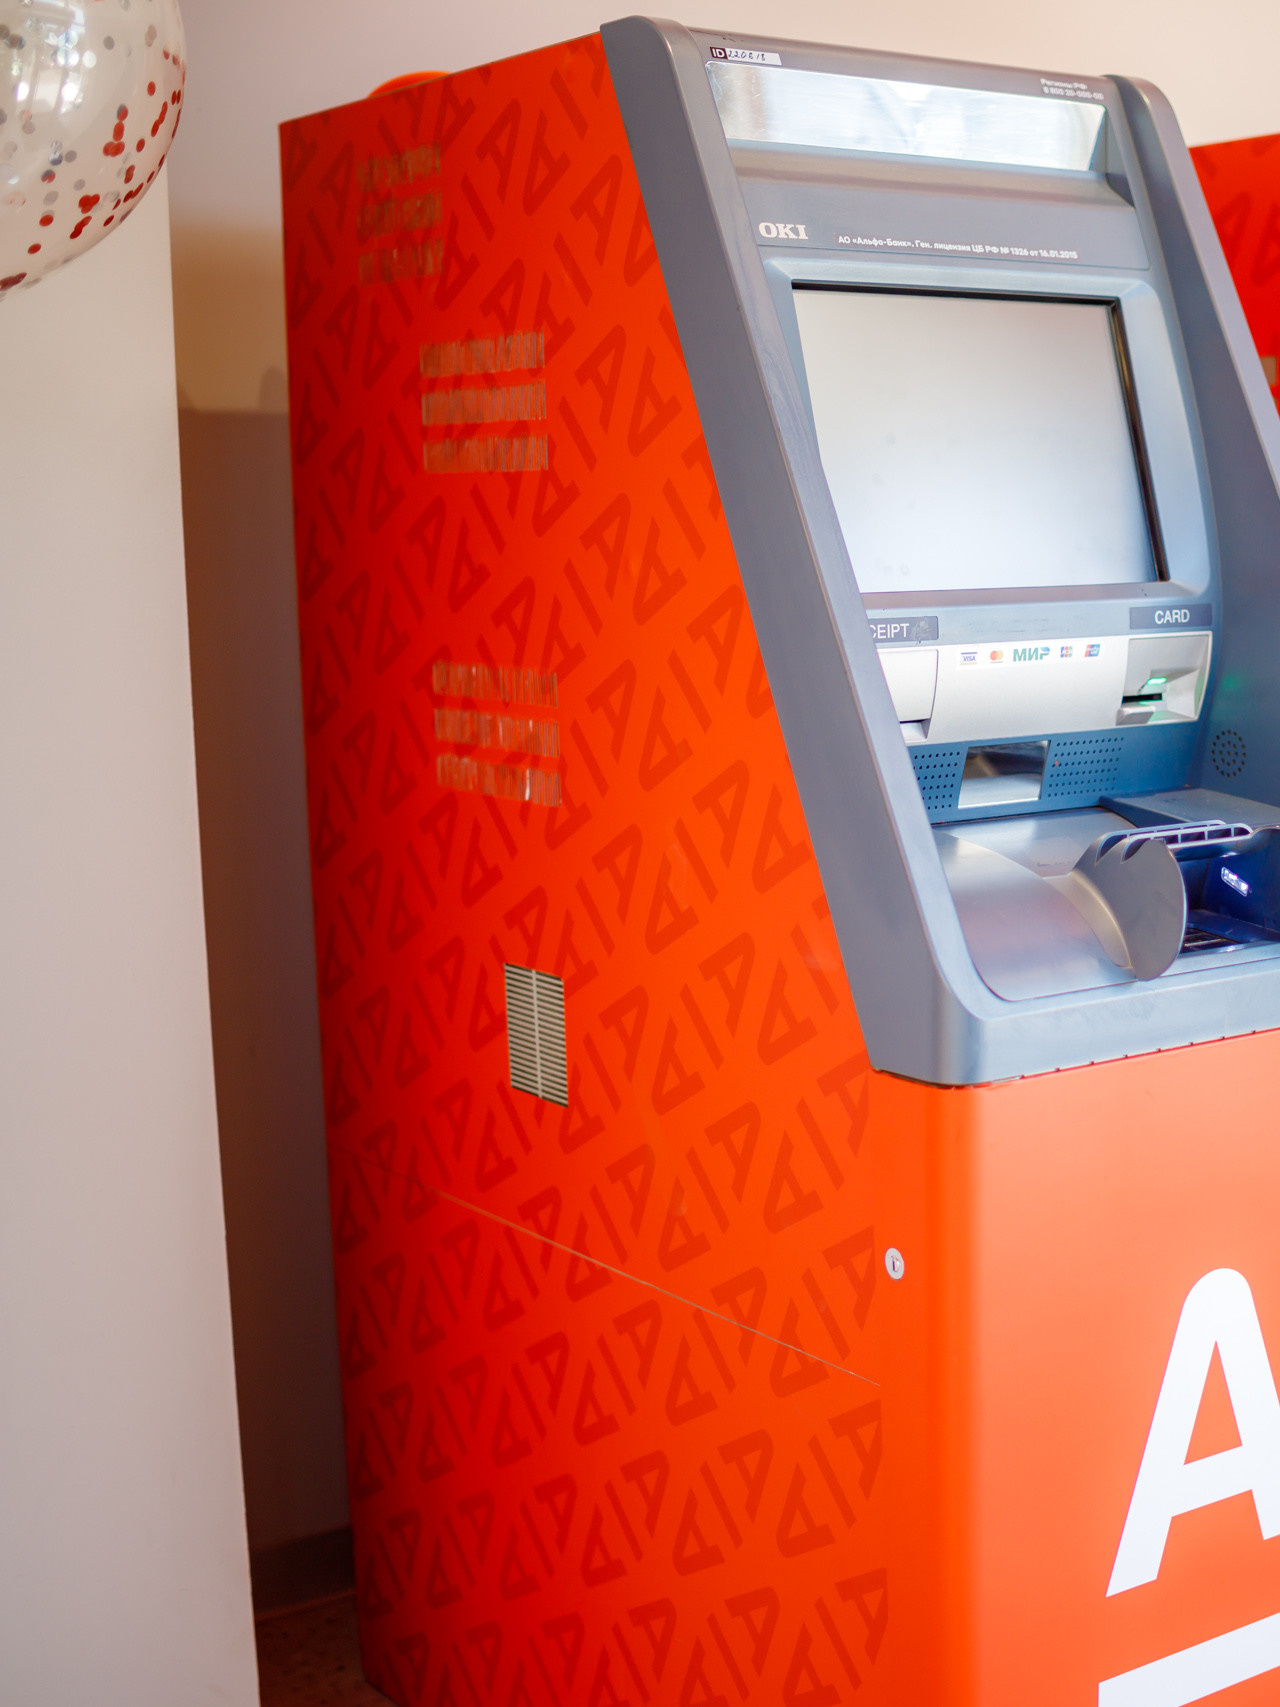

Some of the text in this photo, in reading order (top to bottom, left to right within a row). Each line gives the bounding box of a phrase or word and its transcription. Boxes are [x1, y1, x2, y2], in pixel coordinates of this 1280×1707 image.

[712, 48, 725, 58] ID
[758, 222, 808, 240] OKI
[838, 235, 851, 244] АО
[915, 240, 933, 249] Ген.
[933, 242, 971, 252] лицензия
[971, 244, 985, 253] ЦБ
[1154, 609, 1191, 625] CARD
[1012, 646, 1050, 662] МИР
